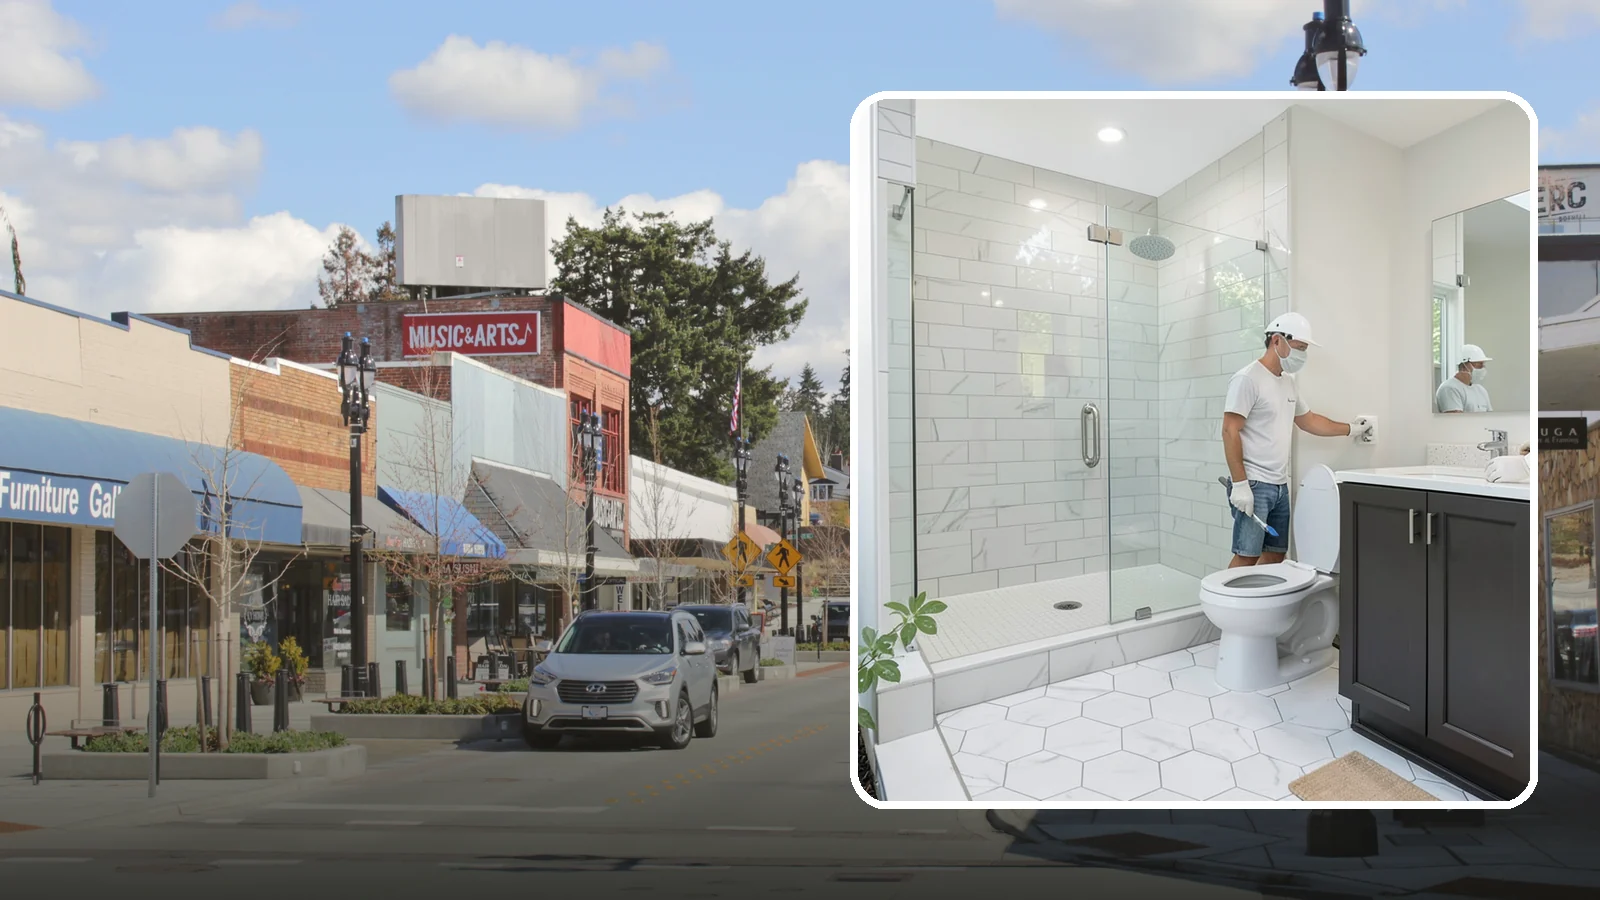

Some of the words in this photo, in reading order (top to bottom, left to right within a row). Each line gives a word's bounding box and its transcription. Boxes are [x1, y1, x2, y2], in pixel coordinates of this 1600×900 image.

[409, 323, 519, 349] MUSIC&ARTS
[0, 472, 79, 515] Furniture
[453, 563, 480, 574] SUSHI
